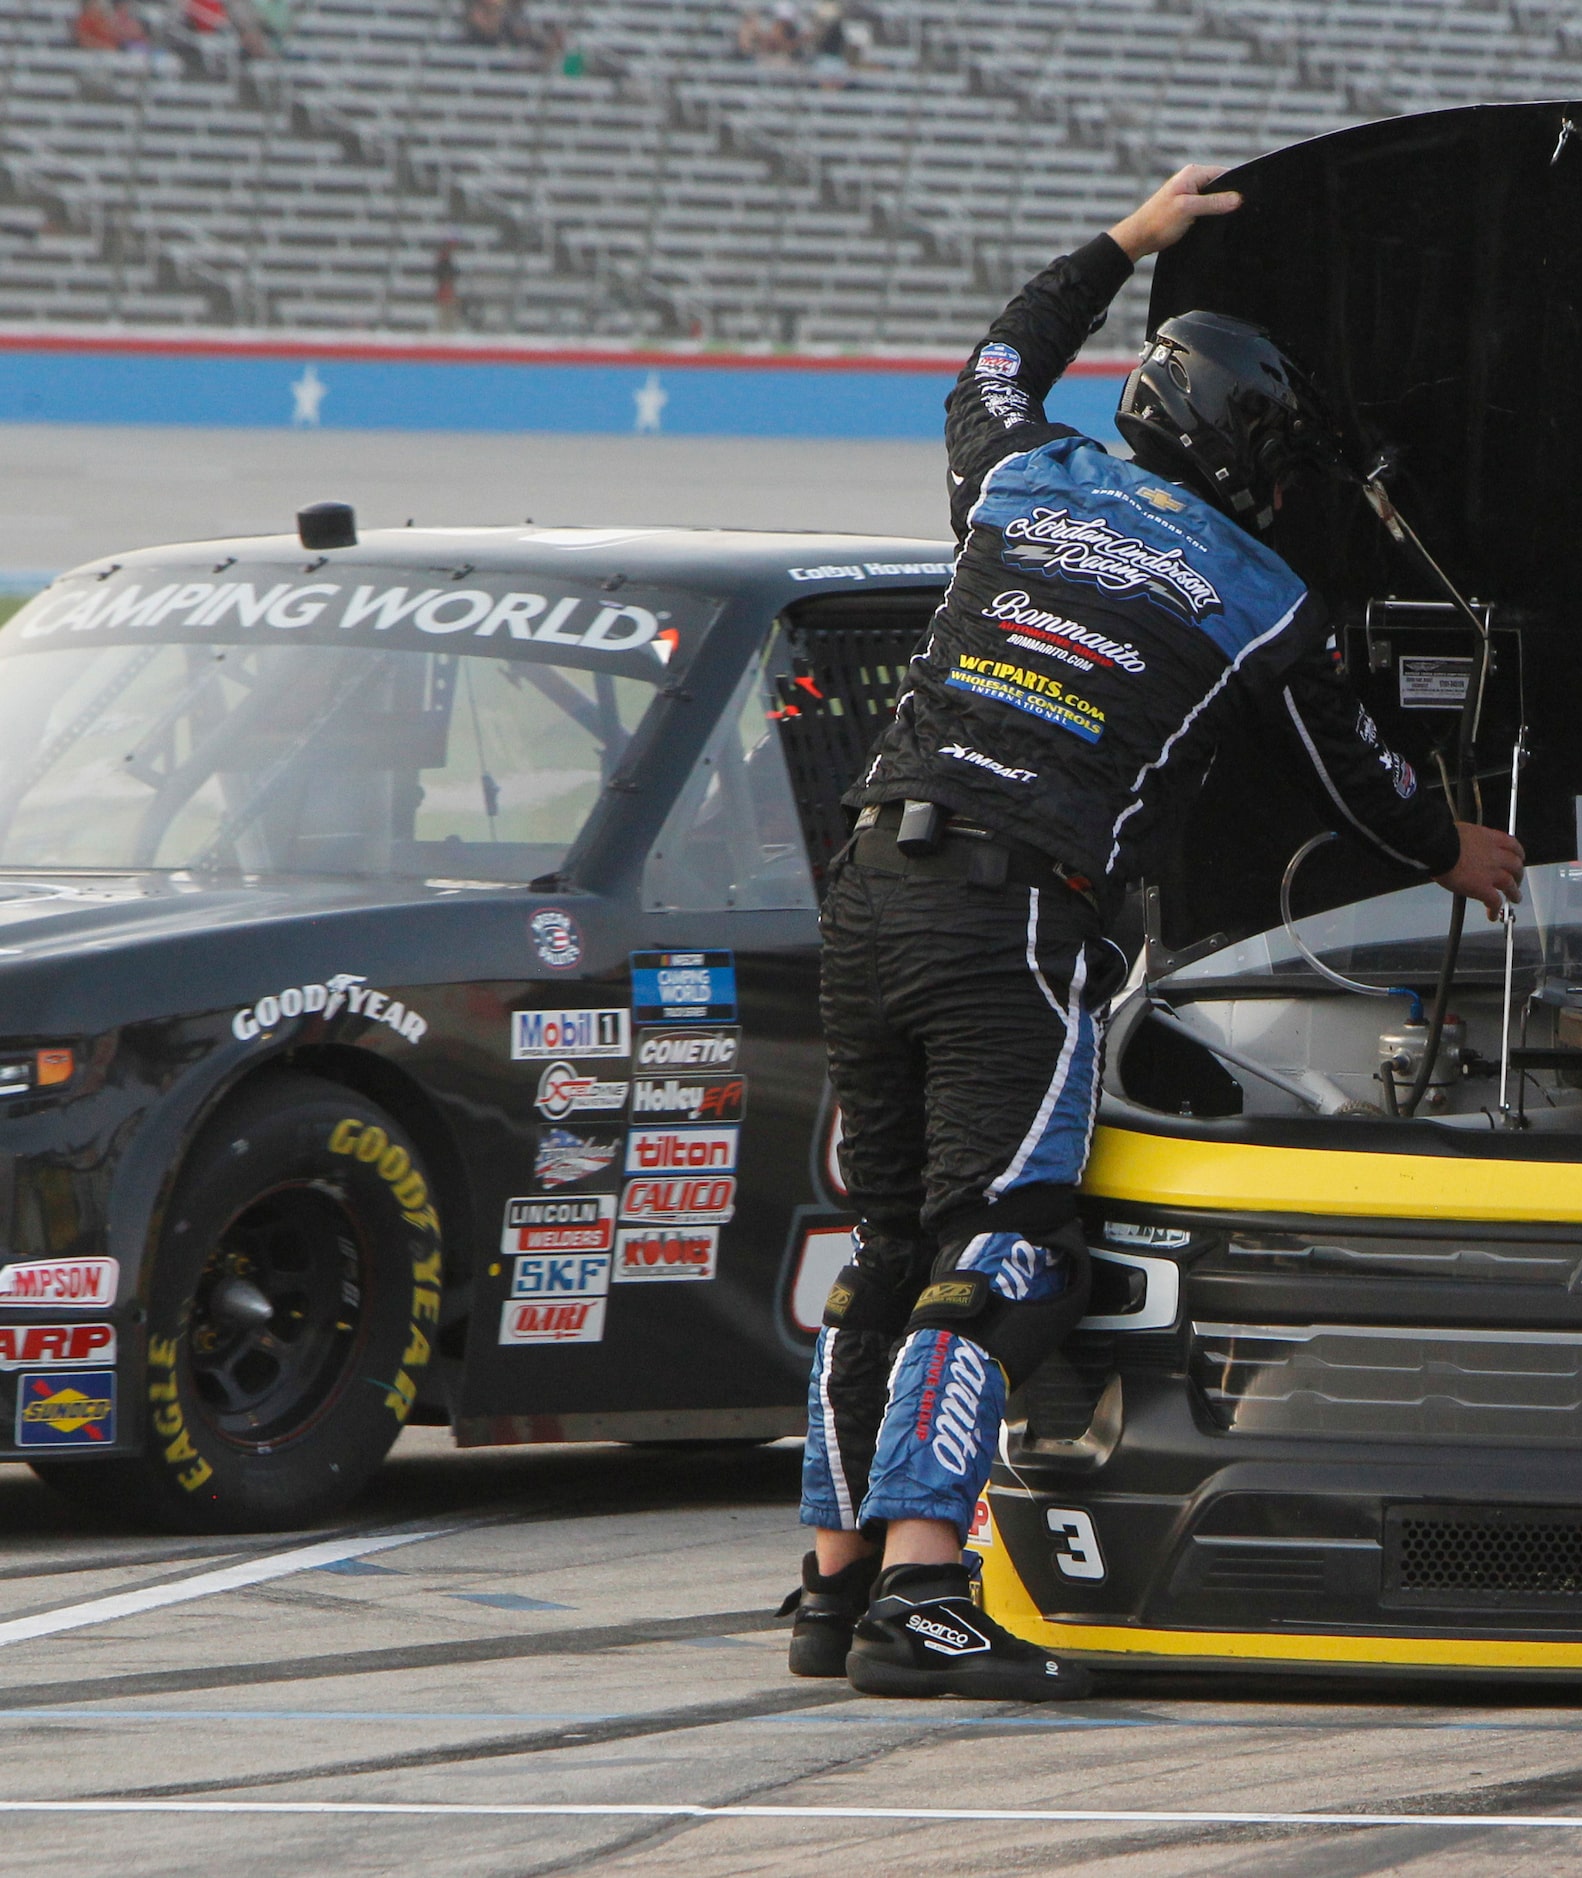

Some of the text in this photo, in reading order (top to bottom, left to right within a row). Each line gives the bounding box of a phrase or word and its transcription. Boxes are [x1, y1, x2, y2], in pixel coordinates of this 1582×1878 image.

[787, 562, 957, 581] Colby Howar
[1005, 507, 1221, 613] Jordan Anderson
[1044, 542, 1151, 589] Racing
[20, 582, 660, 651] CAMPING WORLD
[982, 590, 1146, 674] Bommarito
[1006, 633, 1095, 672] BOMMARITO.COM
[950, 670, 1102, 735] WHOLESALE CONTROLS
[959, 653, 1106, 722] WCIPARTS.COM
[970, 684, 1069, 727] INTERNATIONAL
[964, 750, 1039, 784] IMPACT
[232, 978, 428, 1044] GOODYEAR
[520, 1012, 614, 1048] Mobil 1
[639, 1038, 737, 1064] COMETIC
[633, 1080, 704, 1119] Holley
[635, 1135, 728, 1168] tilton
[511, 1202, 598, 1224] LINCOLN
[624, 1180, 732, 1214] CALICO
[527, 1229, 604, 1248] WELDERS
[517, 1258, 607, 1293] SKF
[515, 1301, 596, 1332] DART
[148, 1333, 213, 1492] EAGLE
[914, 1375, 932, 1441] GROUP
[1046, 1508, 1107, 1580] 3
[909, 1614, 969, 1645] sparco
